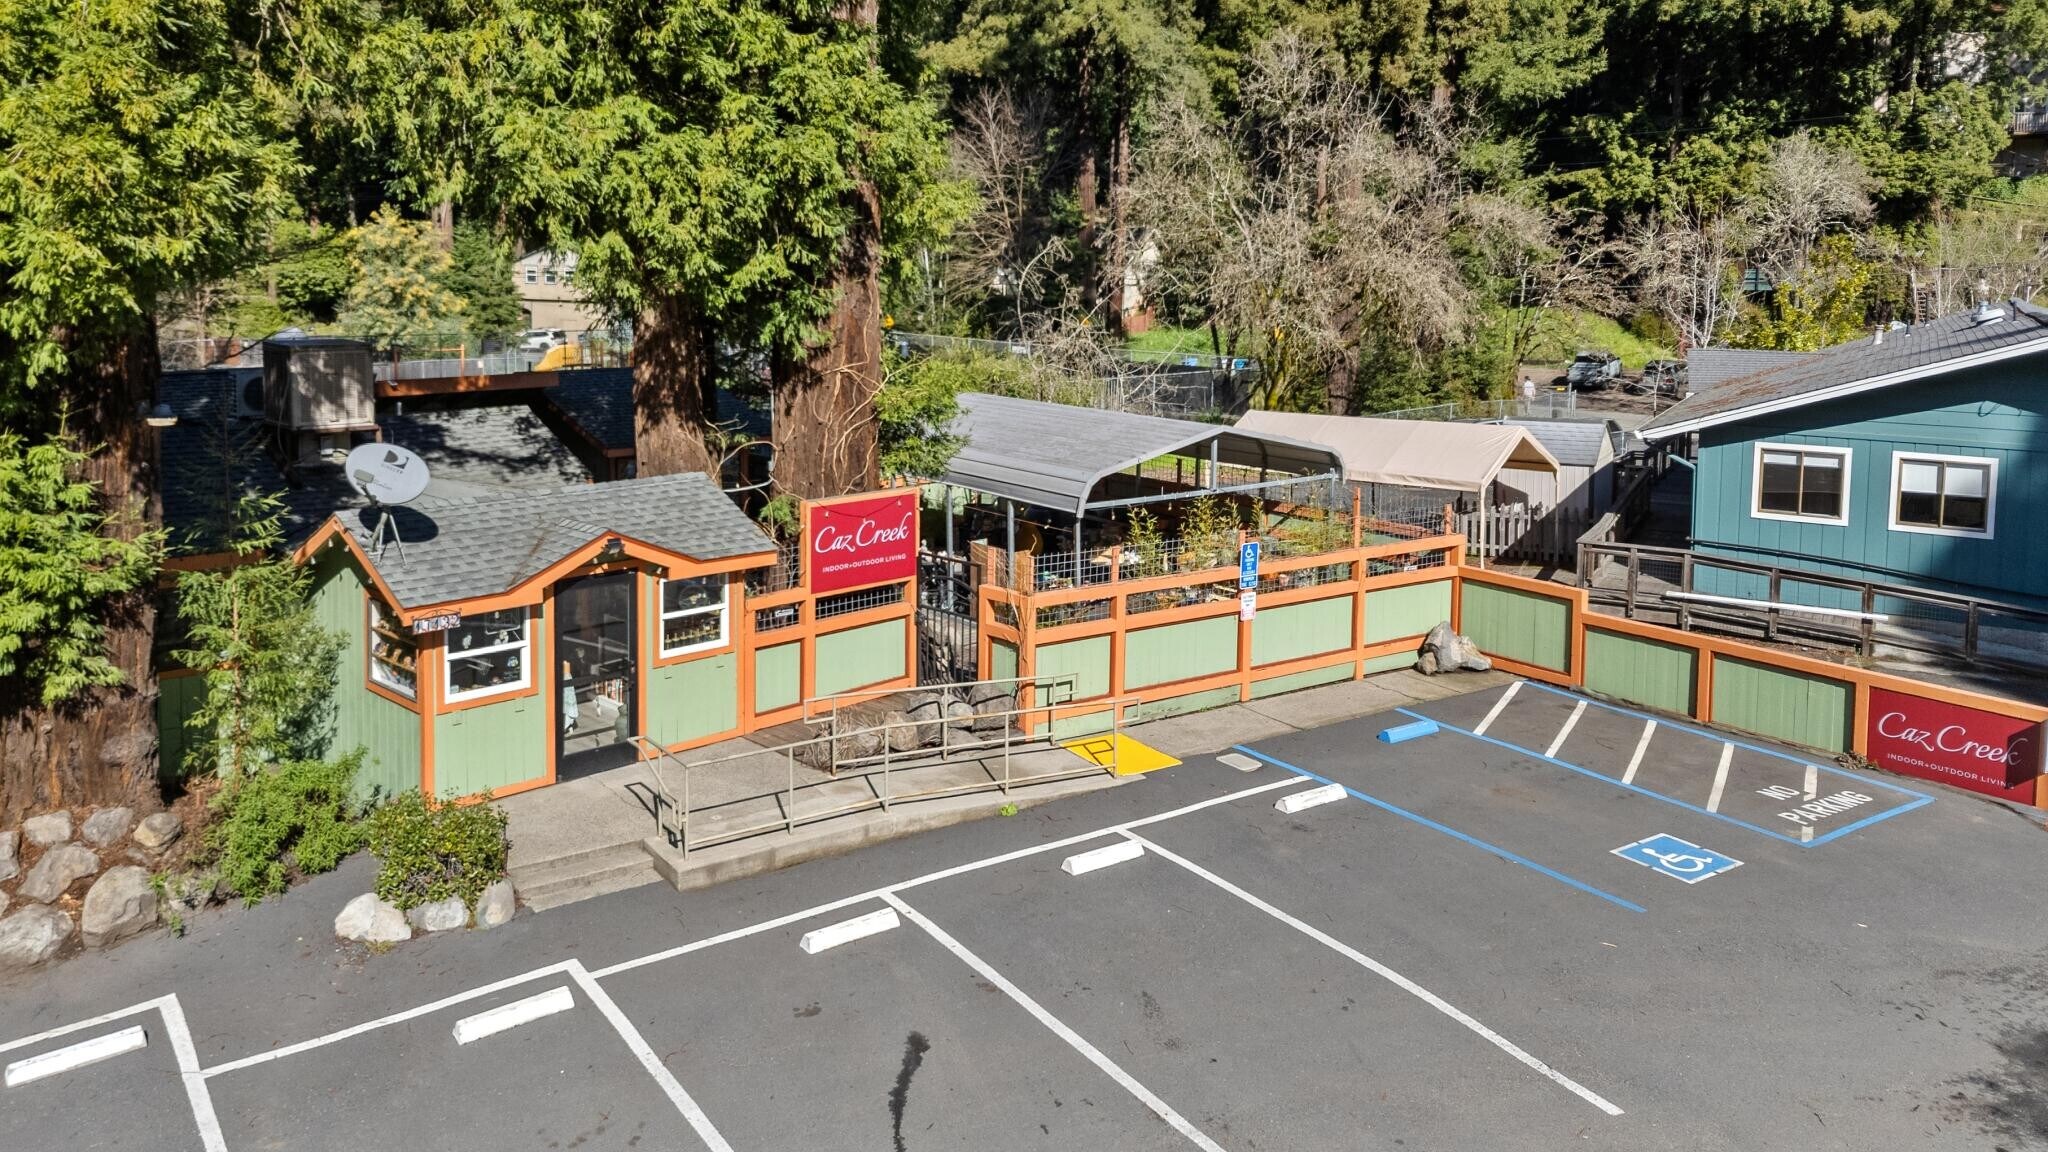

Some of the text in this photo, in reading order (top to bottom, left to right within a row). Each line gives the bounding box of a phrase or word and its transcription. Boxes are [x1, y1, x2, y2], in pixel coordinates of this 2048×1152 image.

[815, 512, 912, 553] Caz Creek
[885, 553, 906, 563] LIVING
[1878, 712, 2029, 766] Caz Creek
[1755, 785, 1801, 801] NO
[1777, 790, 1874, 826] PARKING
